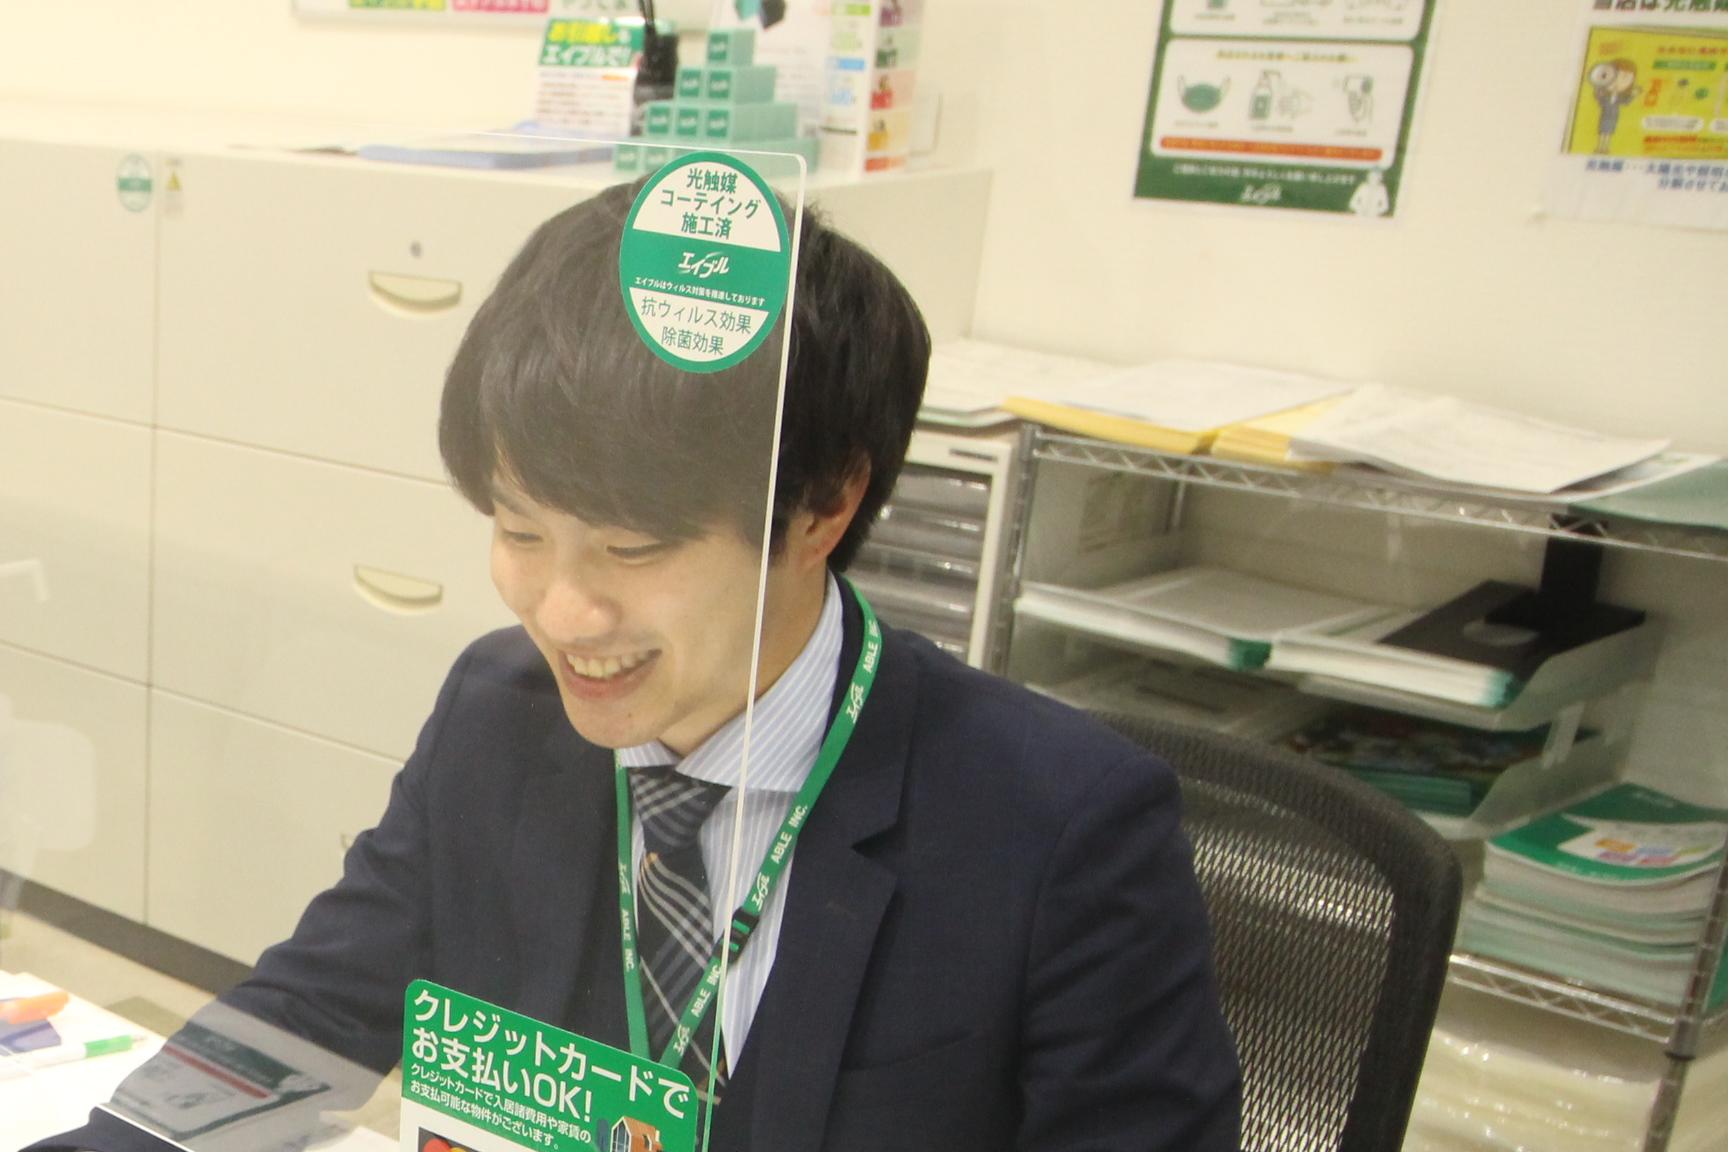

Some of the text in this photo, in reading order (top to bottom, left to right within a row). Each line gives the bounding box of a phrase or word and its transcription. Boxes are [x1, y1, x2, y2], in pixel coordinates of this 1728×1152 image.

[687, 168, 738, 194] 光触媒
[661, 188, 761, 219] コーティング
[681, 211, 732, 240] 施工済
[678, 251, 730, 279] エイブル
[641, 296, 752, 334] 抗ウィルス効果
[661, 326, 724, 356] 除菌効果
[863, 639, 878, 674] ABLE
[771, 804, 809, 864] ABLE INC.
[622, 909, 632, 943] ABLE
[691, 988, 711, 1018] ABLE
[413, 986, 689, 1120] クレジットカードで
[411, 1023, 592, 1124] お支払いOK!
[410, 1079, 559, 1150] お支払可能な物件がございます。
[411, 1062, 590, 1144] クレジットカードで入居諸費用や家賃の
